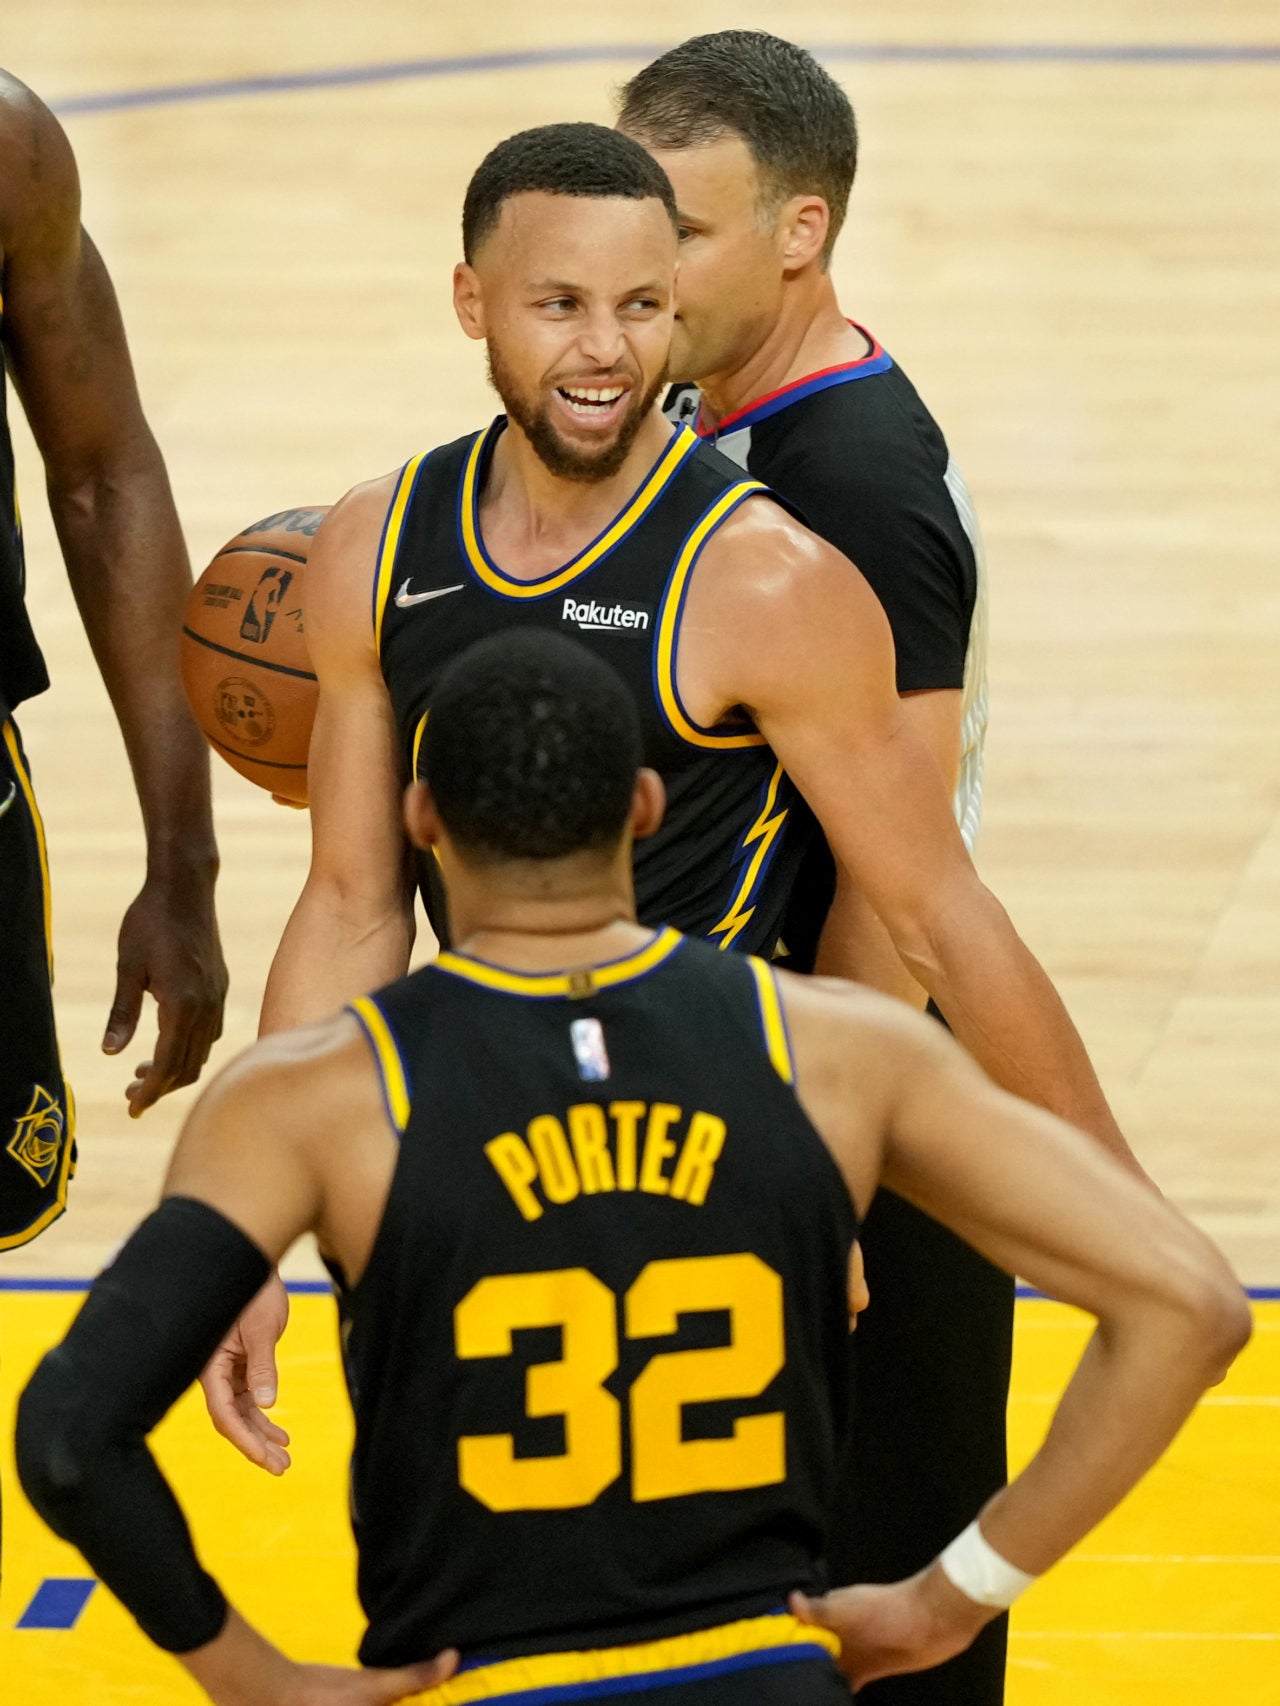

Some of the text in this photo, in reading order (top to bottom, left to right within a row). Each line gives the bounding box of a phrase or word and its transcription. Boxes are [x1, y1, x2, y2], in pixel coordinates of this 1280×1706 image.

[562, 598, 649, 630] Rakuten
[484, 1100, 728, 1222] PORTER
[453, 1252, 787, 1513] 32
